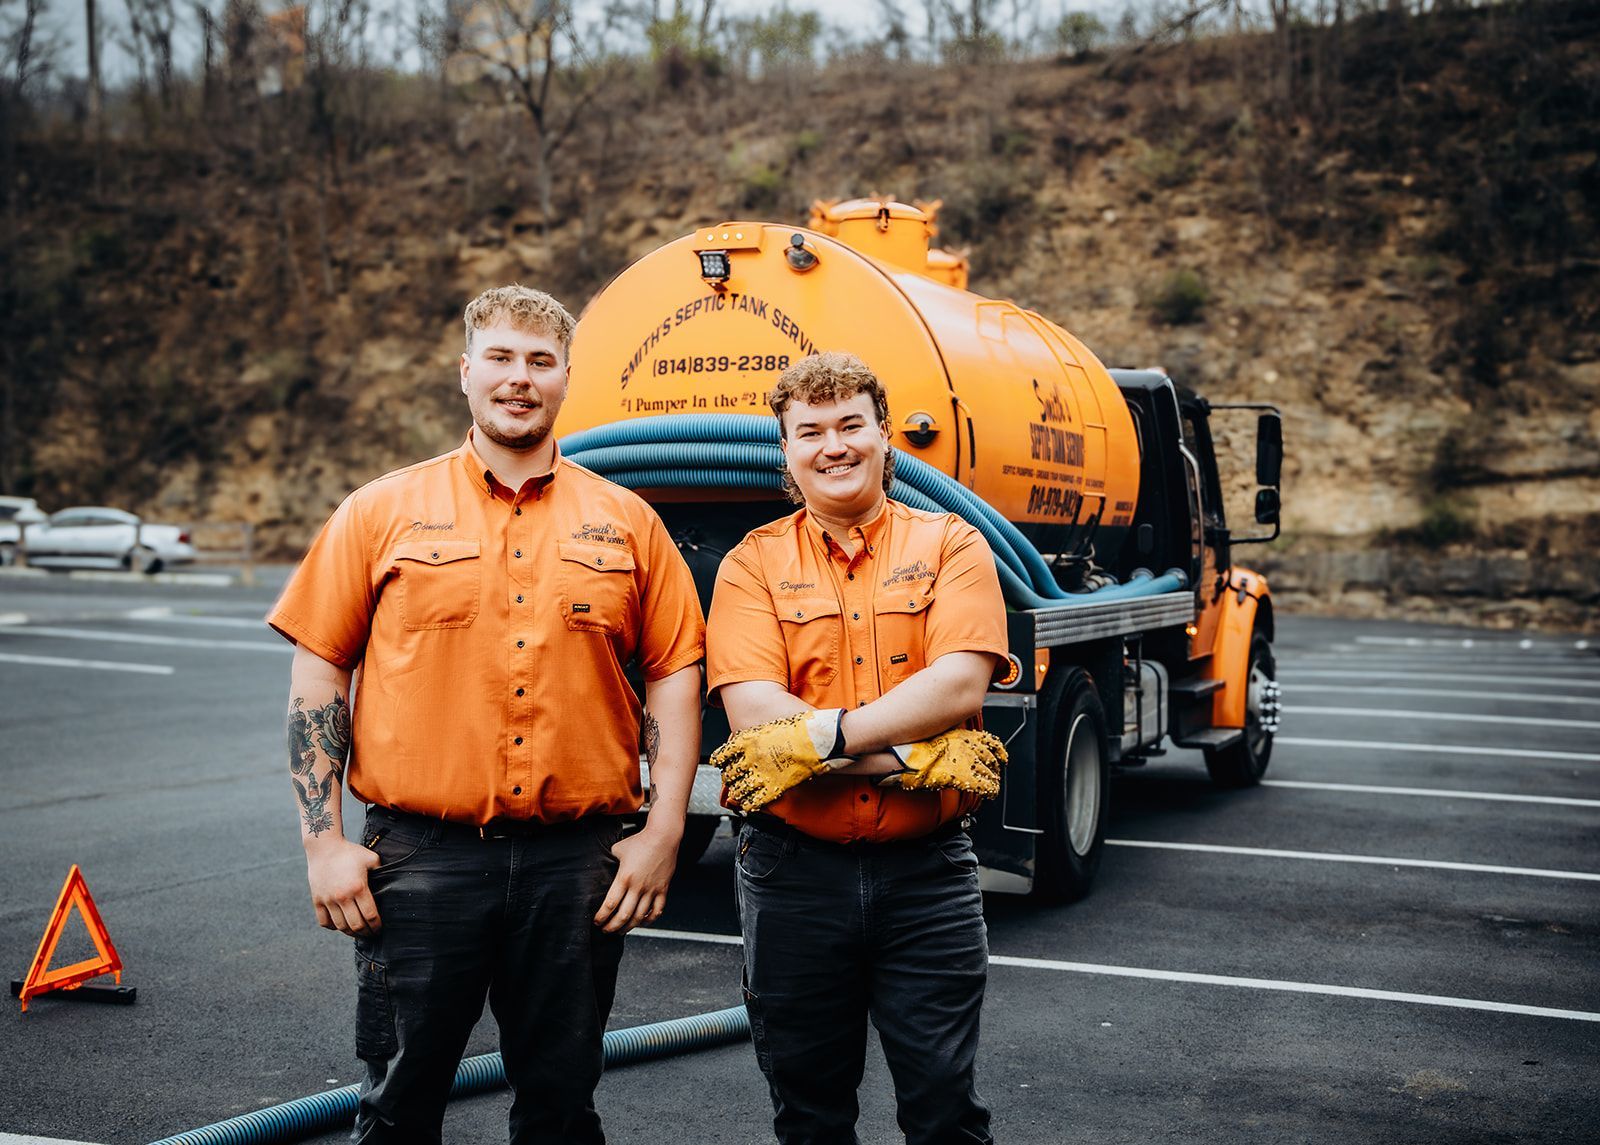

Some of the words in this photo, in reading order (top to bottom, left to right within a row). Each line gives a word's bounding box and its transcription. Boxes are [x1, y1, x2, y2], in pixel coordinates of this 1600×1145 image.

[620, 317, 672, 390] SMITH'S
[675, 292, 726, 327] SEPTIC
[730, 292, 769, 320] TANK
[771, 308, 820, 355] SERVI
[652, 355, 790, 377] (814)839-2388
[635, 396, 688, 413] Pumper
[714, 393, 738, 407] the
[581, 523, 617, 536] Smith's
[591, 534, 605, 542] TANK
[892, 559, 927, 575] Smith's
[901, 573, 915, 582] TANK
